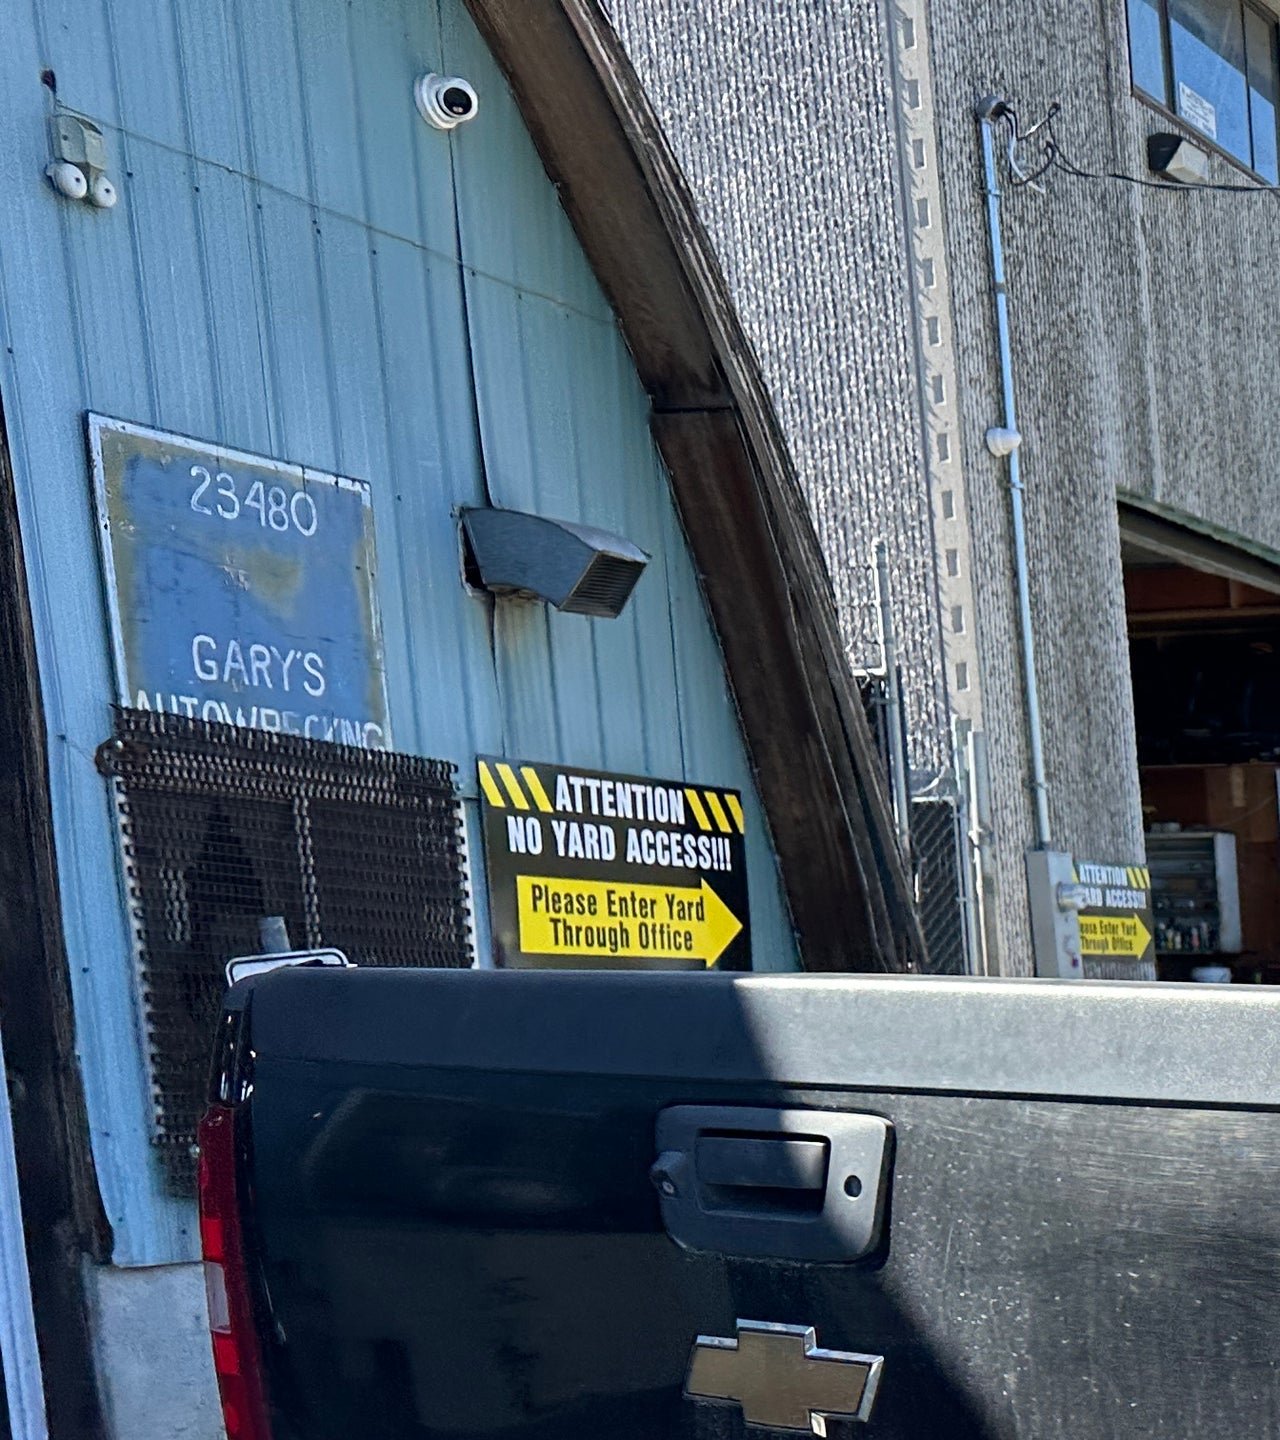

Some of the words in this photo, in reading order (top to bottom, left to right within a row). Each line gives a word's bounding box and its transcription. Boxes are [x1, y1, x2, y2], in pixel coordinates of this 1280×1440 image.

[190, 465, 318, 536] 23480
[192, 634, 326, 697] GARY'S
[556, 774, 686, 825] ATTENTION
[507, 815, 543, 855] NO
[551, 820, 616, 861] YARD
[626, 828, 732, 871] ACCESS!!!
[1079, 863, 1128, 887] ATTENTION
[531, 884, 597, 916] Please
[607, 889, 657, 918] Enter
[665, 893, 705, 921] Yard
[550, 918, 629, 953] Through
[639, 922, 693, 951] Office
[1080, 935, 1109, 953] Through
[1112, 936, 1133, 951] Office
[1099, 920, 1119, 935] Enter
[1120, 921, 1137, 936] Yard
